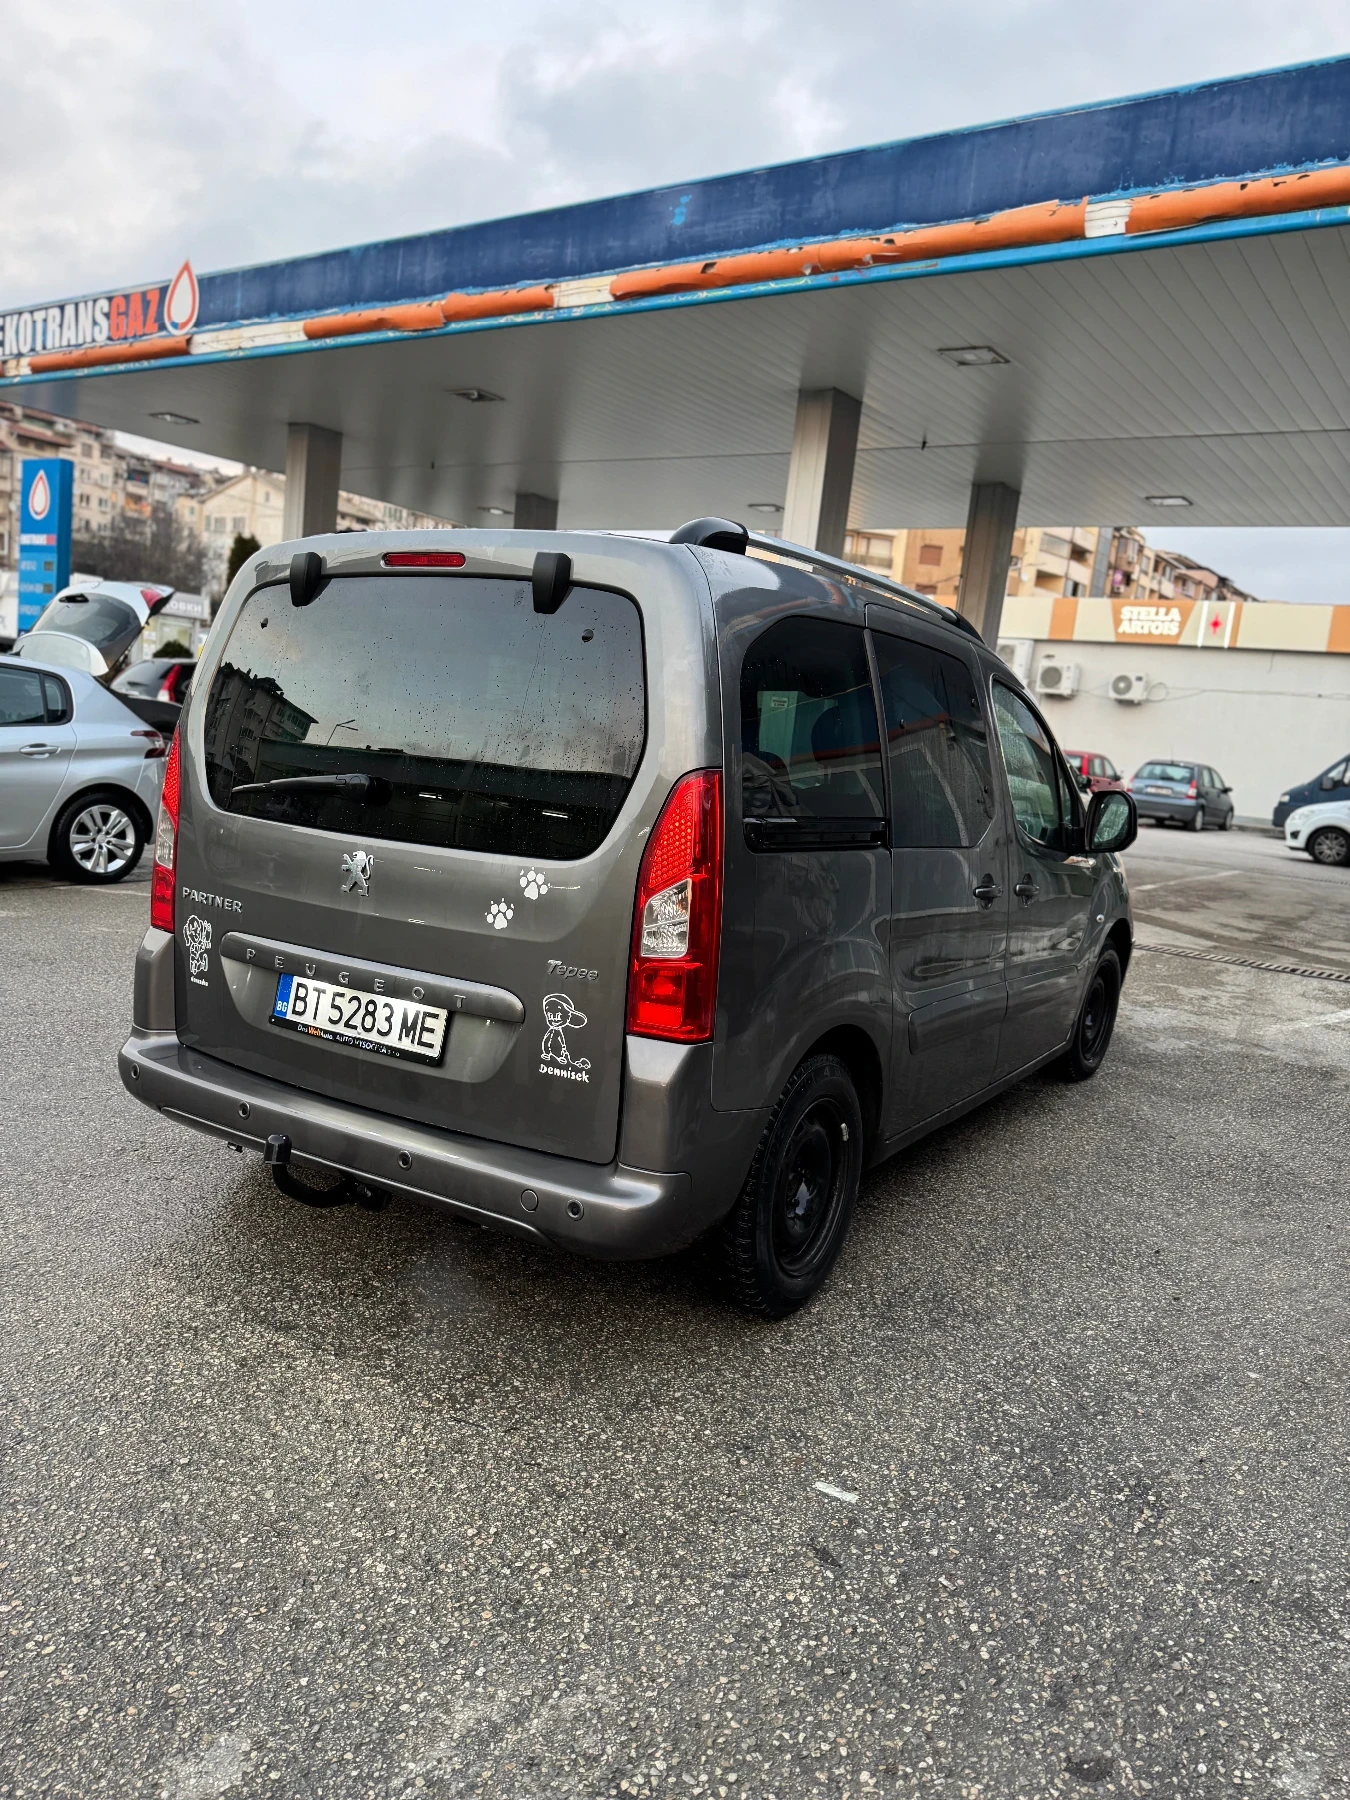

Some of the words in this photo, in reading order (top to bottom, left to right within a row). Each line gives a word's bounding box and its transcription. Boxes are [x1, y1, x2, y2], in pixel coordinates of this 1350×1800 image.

[1120, 606, 1181, 621] STELLA
[1118, 620, 1180, 635] ARTOIS
[183, 887, 242, 912] PARTNER
[246, 948, 467, 1009] PEUGEOT
[548, 959, 598, 980] Tepee
[276, 1001, 288, 1013] BG
